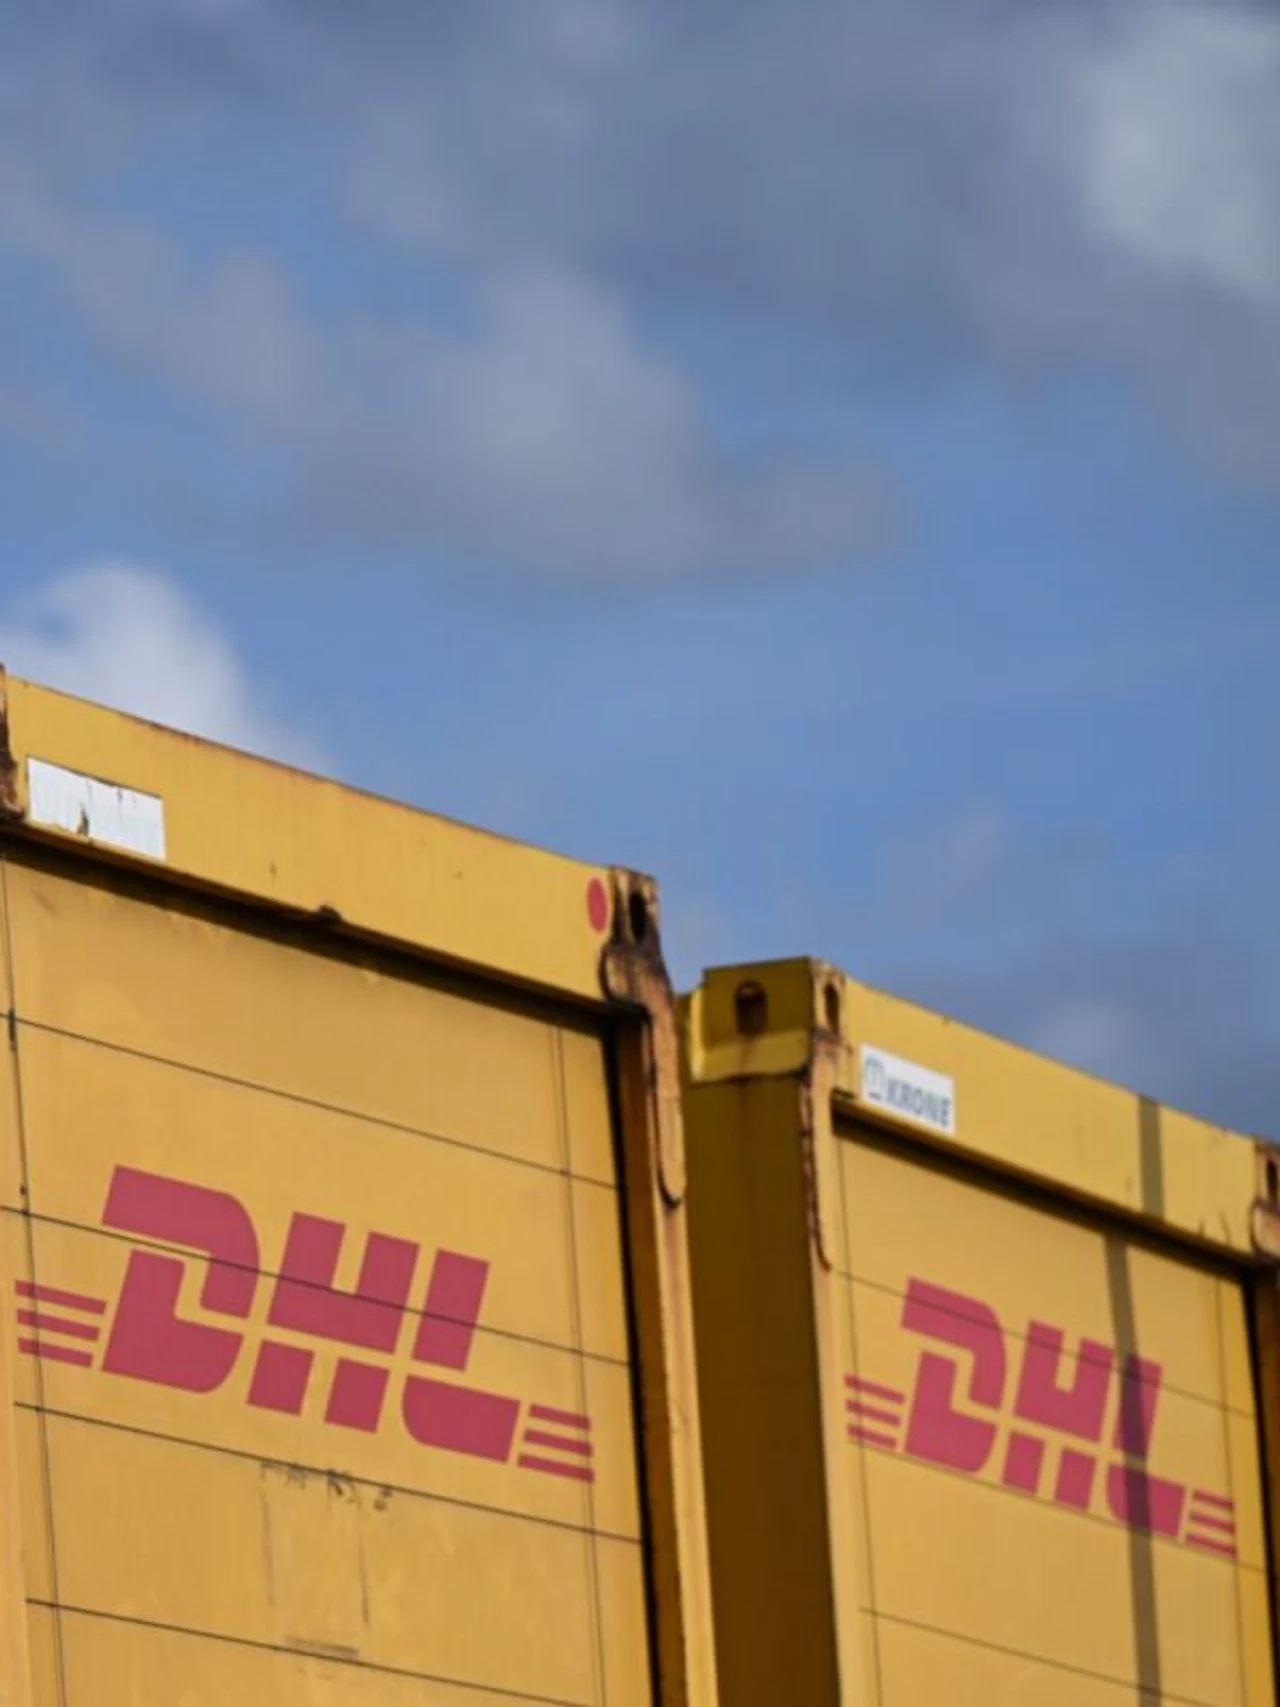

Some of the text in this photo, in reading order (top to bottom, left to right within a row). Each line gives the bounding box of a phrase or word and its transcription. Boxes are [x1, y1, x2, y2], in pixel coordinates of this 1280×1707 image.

[887, 1077, 950, 1127] KRONE
[101, 1165, 520, 1463] DHL
[901, 1277, 1185, 1537] DHL
